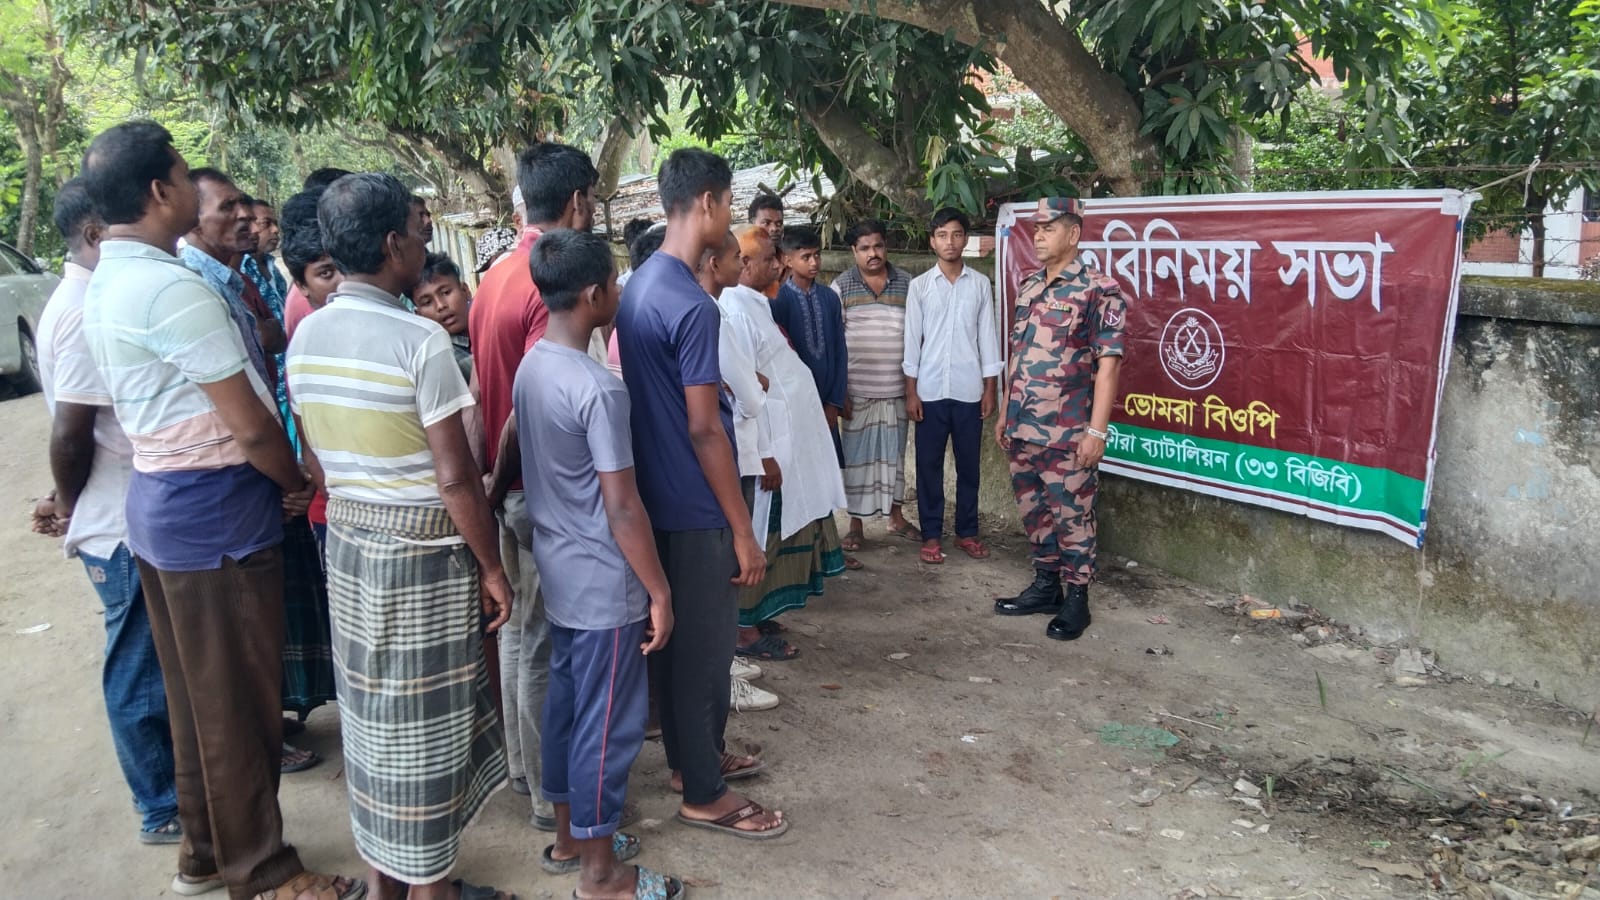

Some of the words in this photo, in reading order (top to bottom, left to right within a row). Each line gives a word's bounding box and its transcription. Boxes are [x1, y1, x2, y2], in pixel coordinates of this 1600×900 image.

[1270, 231, 1395, 312] সভা
[1125, 393, 1197, 427] ভোমরা
[1203, 395, 1280, 439] বিওপি
[1139, 435, 1230, 471] ব্যাটালিয়ন
[1235, 452, 1278, 480] (৩৩
[1284, 456, 1362, 503] বিজিবি)
